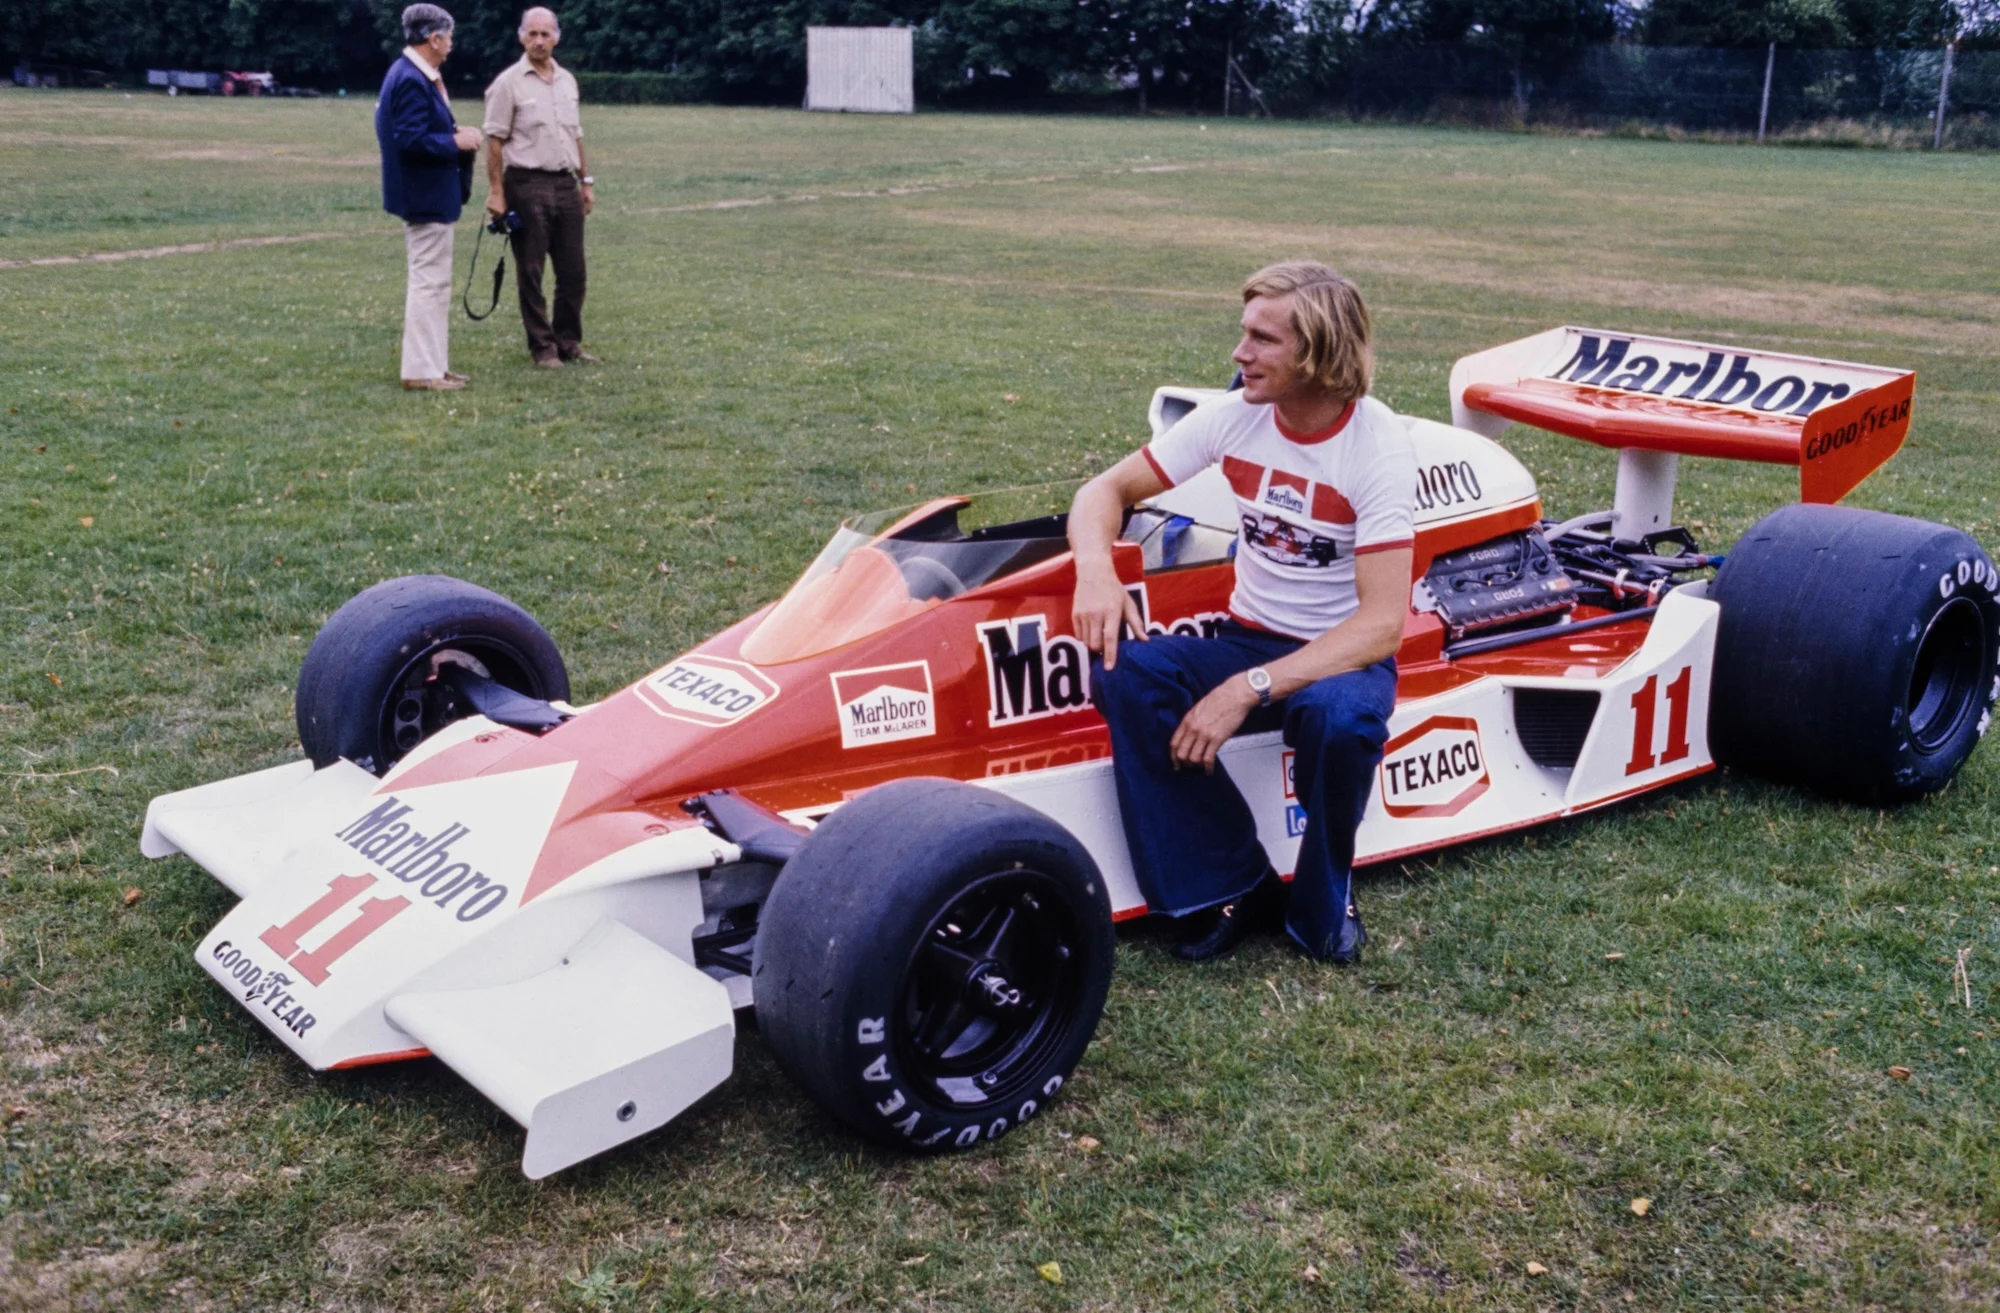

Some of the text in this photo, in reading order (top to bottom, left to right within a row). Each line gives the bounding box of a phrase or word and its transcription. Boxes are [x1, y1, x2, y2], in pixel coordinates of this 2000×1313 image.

[1546, 335, 1872, 416] Marlbor
[1468, 548, 1500, 562] FORD
[657, 665, 757, 714] TEXACO
[850, 695, 927, 726] Marlboro
[854, 719, 927, 738] TEAM McLAREN
[1625, 665, 1692, 777] 11
[1385, 740, 1480, 795] TEXACO
[334, 796, 509, 922] Marlboro
[258, 872, 413, 987] 11
